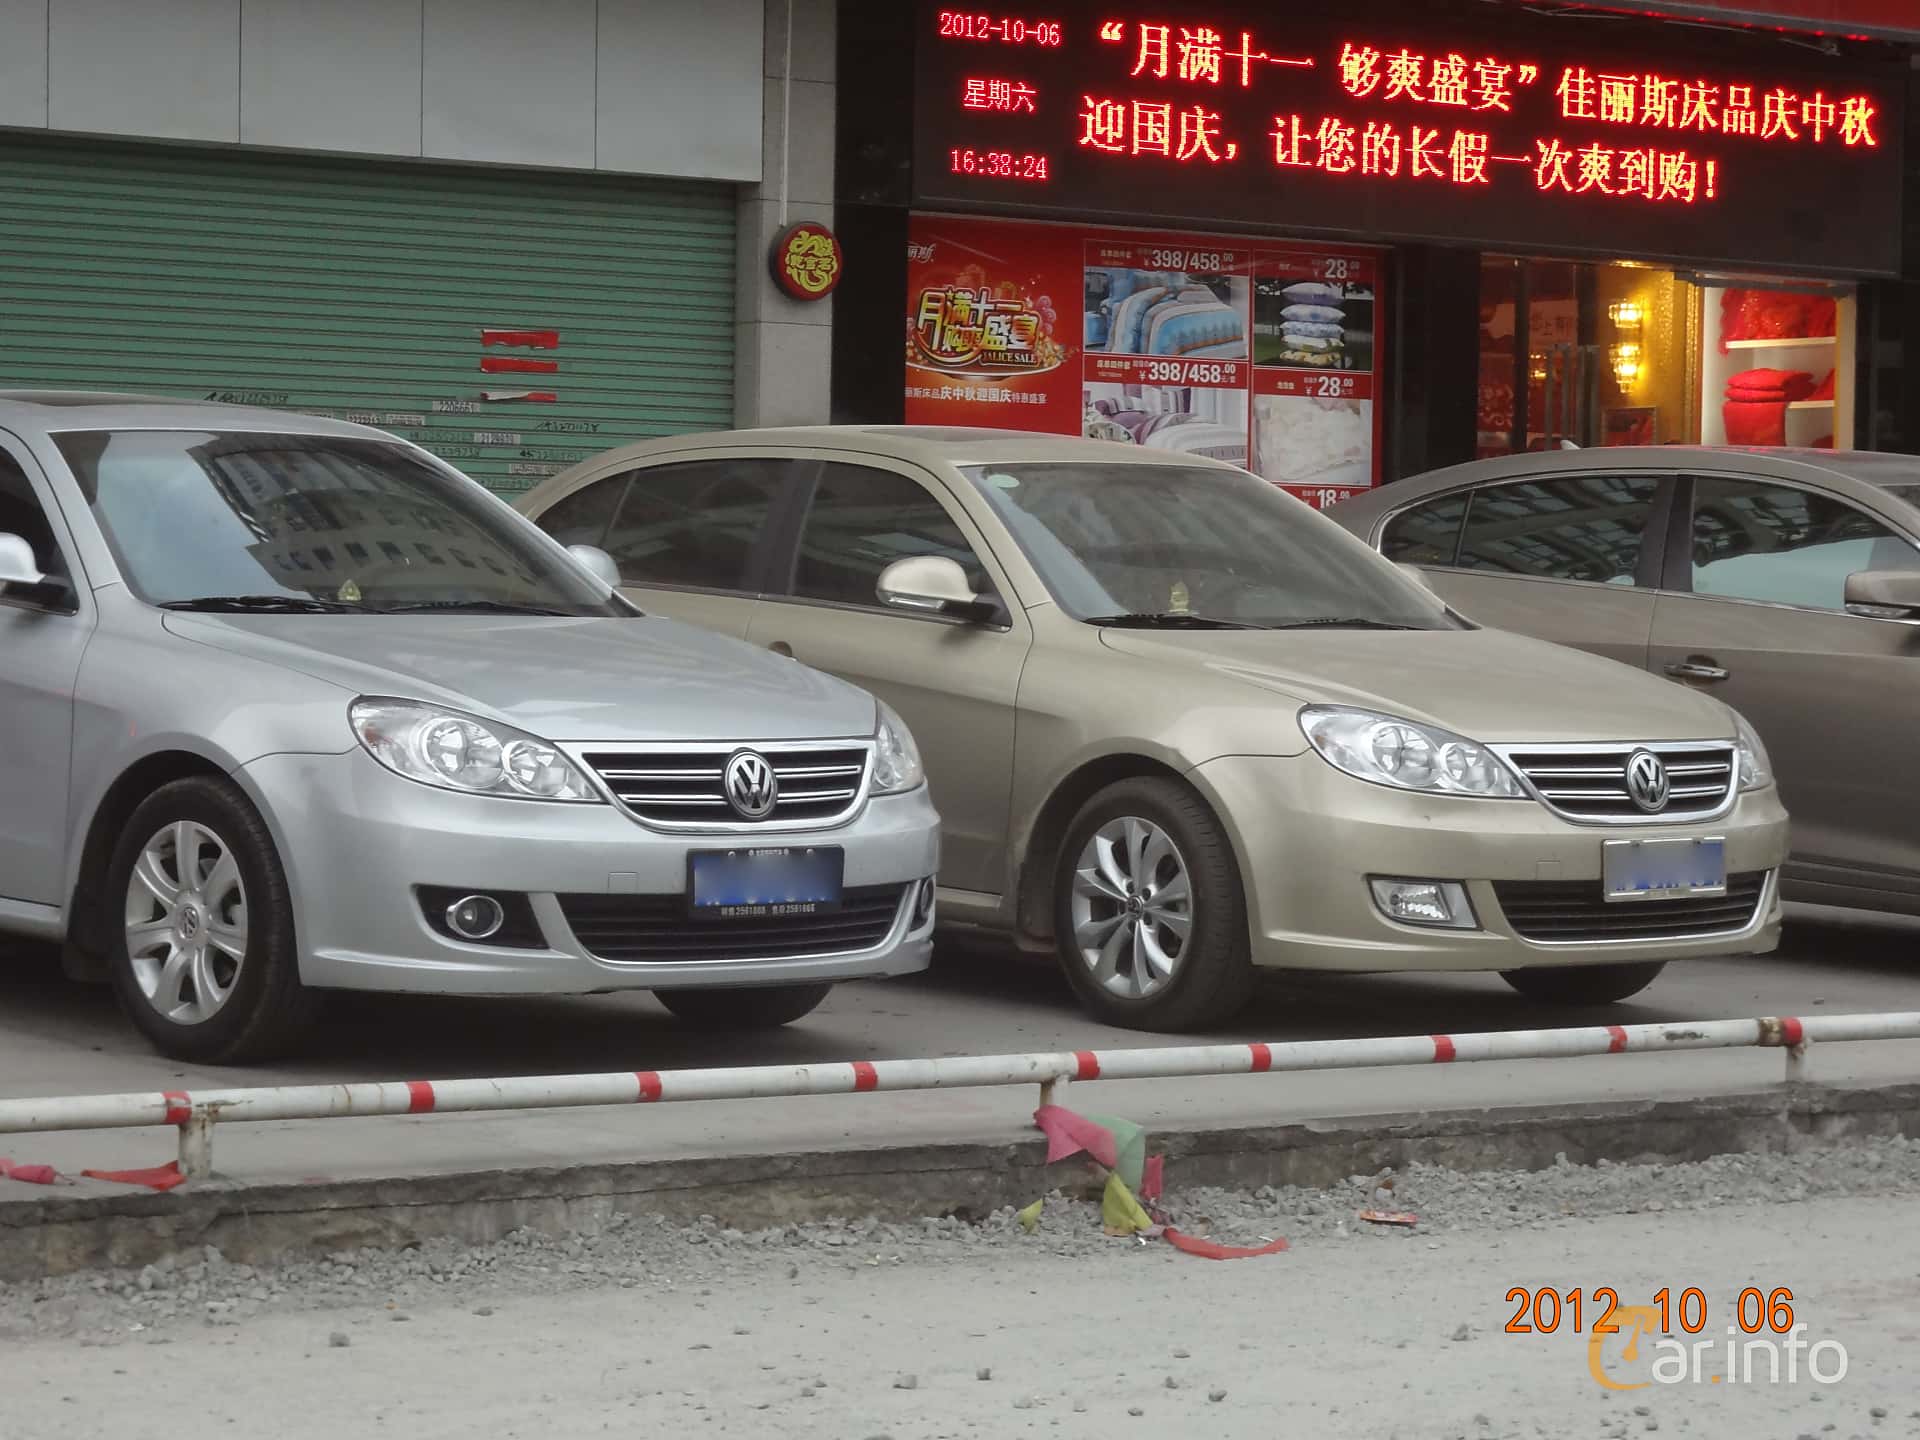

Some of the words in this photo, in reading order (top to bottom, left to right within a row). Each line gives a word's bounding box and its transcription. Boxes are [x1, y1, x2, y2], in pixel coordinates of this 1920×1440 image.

[939, 12, 1061, 46] 2012-10-06
[963, 79, 1037, 113] 星期六
[950, 148, 1048, 180] 16:38:24
